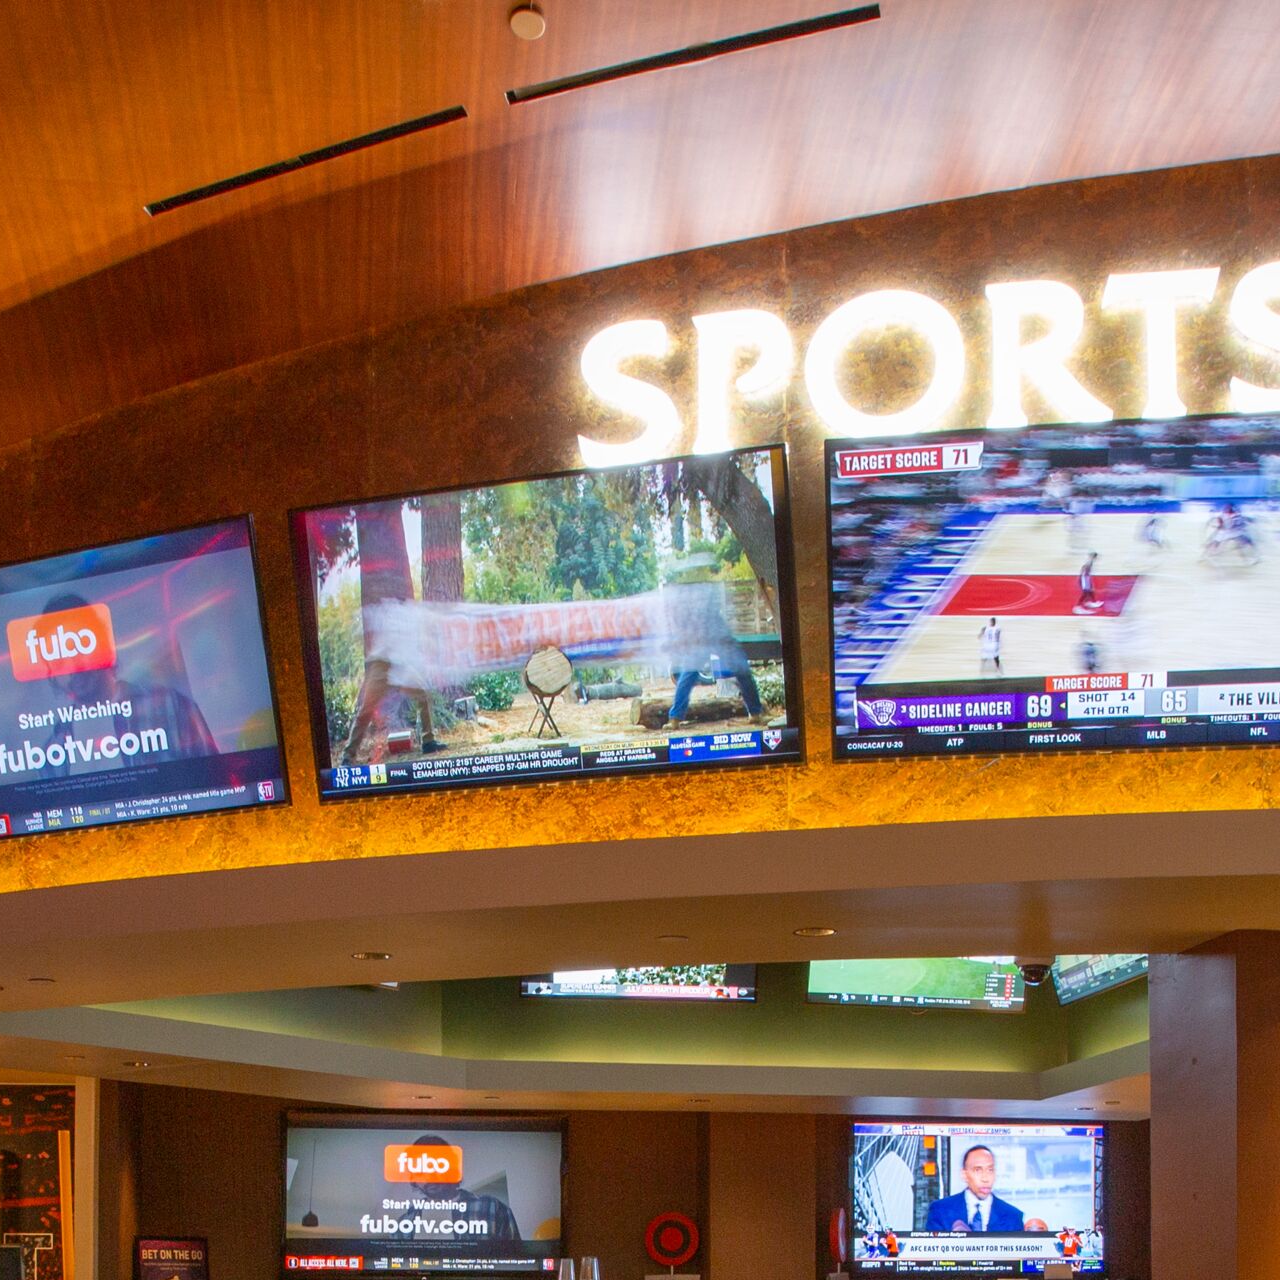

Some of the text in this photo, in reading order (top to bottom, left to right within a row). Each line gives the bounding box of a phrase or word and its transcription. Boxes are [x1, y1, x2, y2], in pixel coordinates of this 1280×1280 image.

[844, 449, 968, 471] TARGET SCORE 71
[26, 625, 97, 664] fubo
[1052, 674, 1154, 690] TARGET SCORE 71
[1078, 692, 1135, 702] SHOT 14
[1161, 690, 1187, 712] 65
[1228, 693, 1253, 706] THE
[909, 703, 962, 719] SIDELINE
[965, 701, 1012, 717] CANCER
[1026, 695, 1052, 717] 69
[1083, 705, 1129, 715] 4TH QTR
[19, 700, 133, 730] Start Watching
[1161, 716, 1187, 724] BONUS
[1210, 714, 1250, 722] TIMEOUTS:
[917, 725, 955, 733] TIMEOUTS:
[1147, 730, 1167, 739] MLB
[1250, 727, 1268, 736] NFL
[713, 735, 729, 744] BID
[731, 733, 752, 742] NOW
[946, 738, 964, 747] ATP
[1029, 733, 1081, 744] FIRST LOOK
[847, 741, 903, 750] CONCACAF U-20
[412, 750, 562, 770] SOTO (NYY): 21ST CAREER MULTI-HR GAME
[351, 768, 361, 776] TB
[390, 768, 408, 777] FINAL
[413, 758, 578, 779] LEMAHIEU (NYY): SNAPPED 57-GM HR DROUGHT
[352, 776, 367, 785] NYY
[46, 809, 63, 819] MEM
[48, 815, 84, 827] MIA 120
[397, 1152, 450, 1174] fubo
[383, 1199, 467, 1212] Start Watching
[360, 1214, 488, 1235] fubotv.com
[142, 1249, 203, 1260] BET ON THE GO
[910, 1245, 922, 1253] AFC
[923, 1245, 939, 1253] EAST
[940, 1245, 950, 1253] QB
[951, 1245, 964, 1253] YOU
